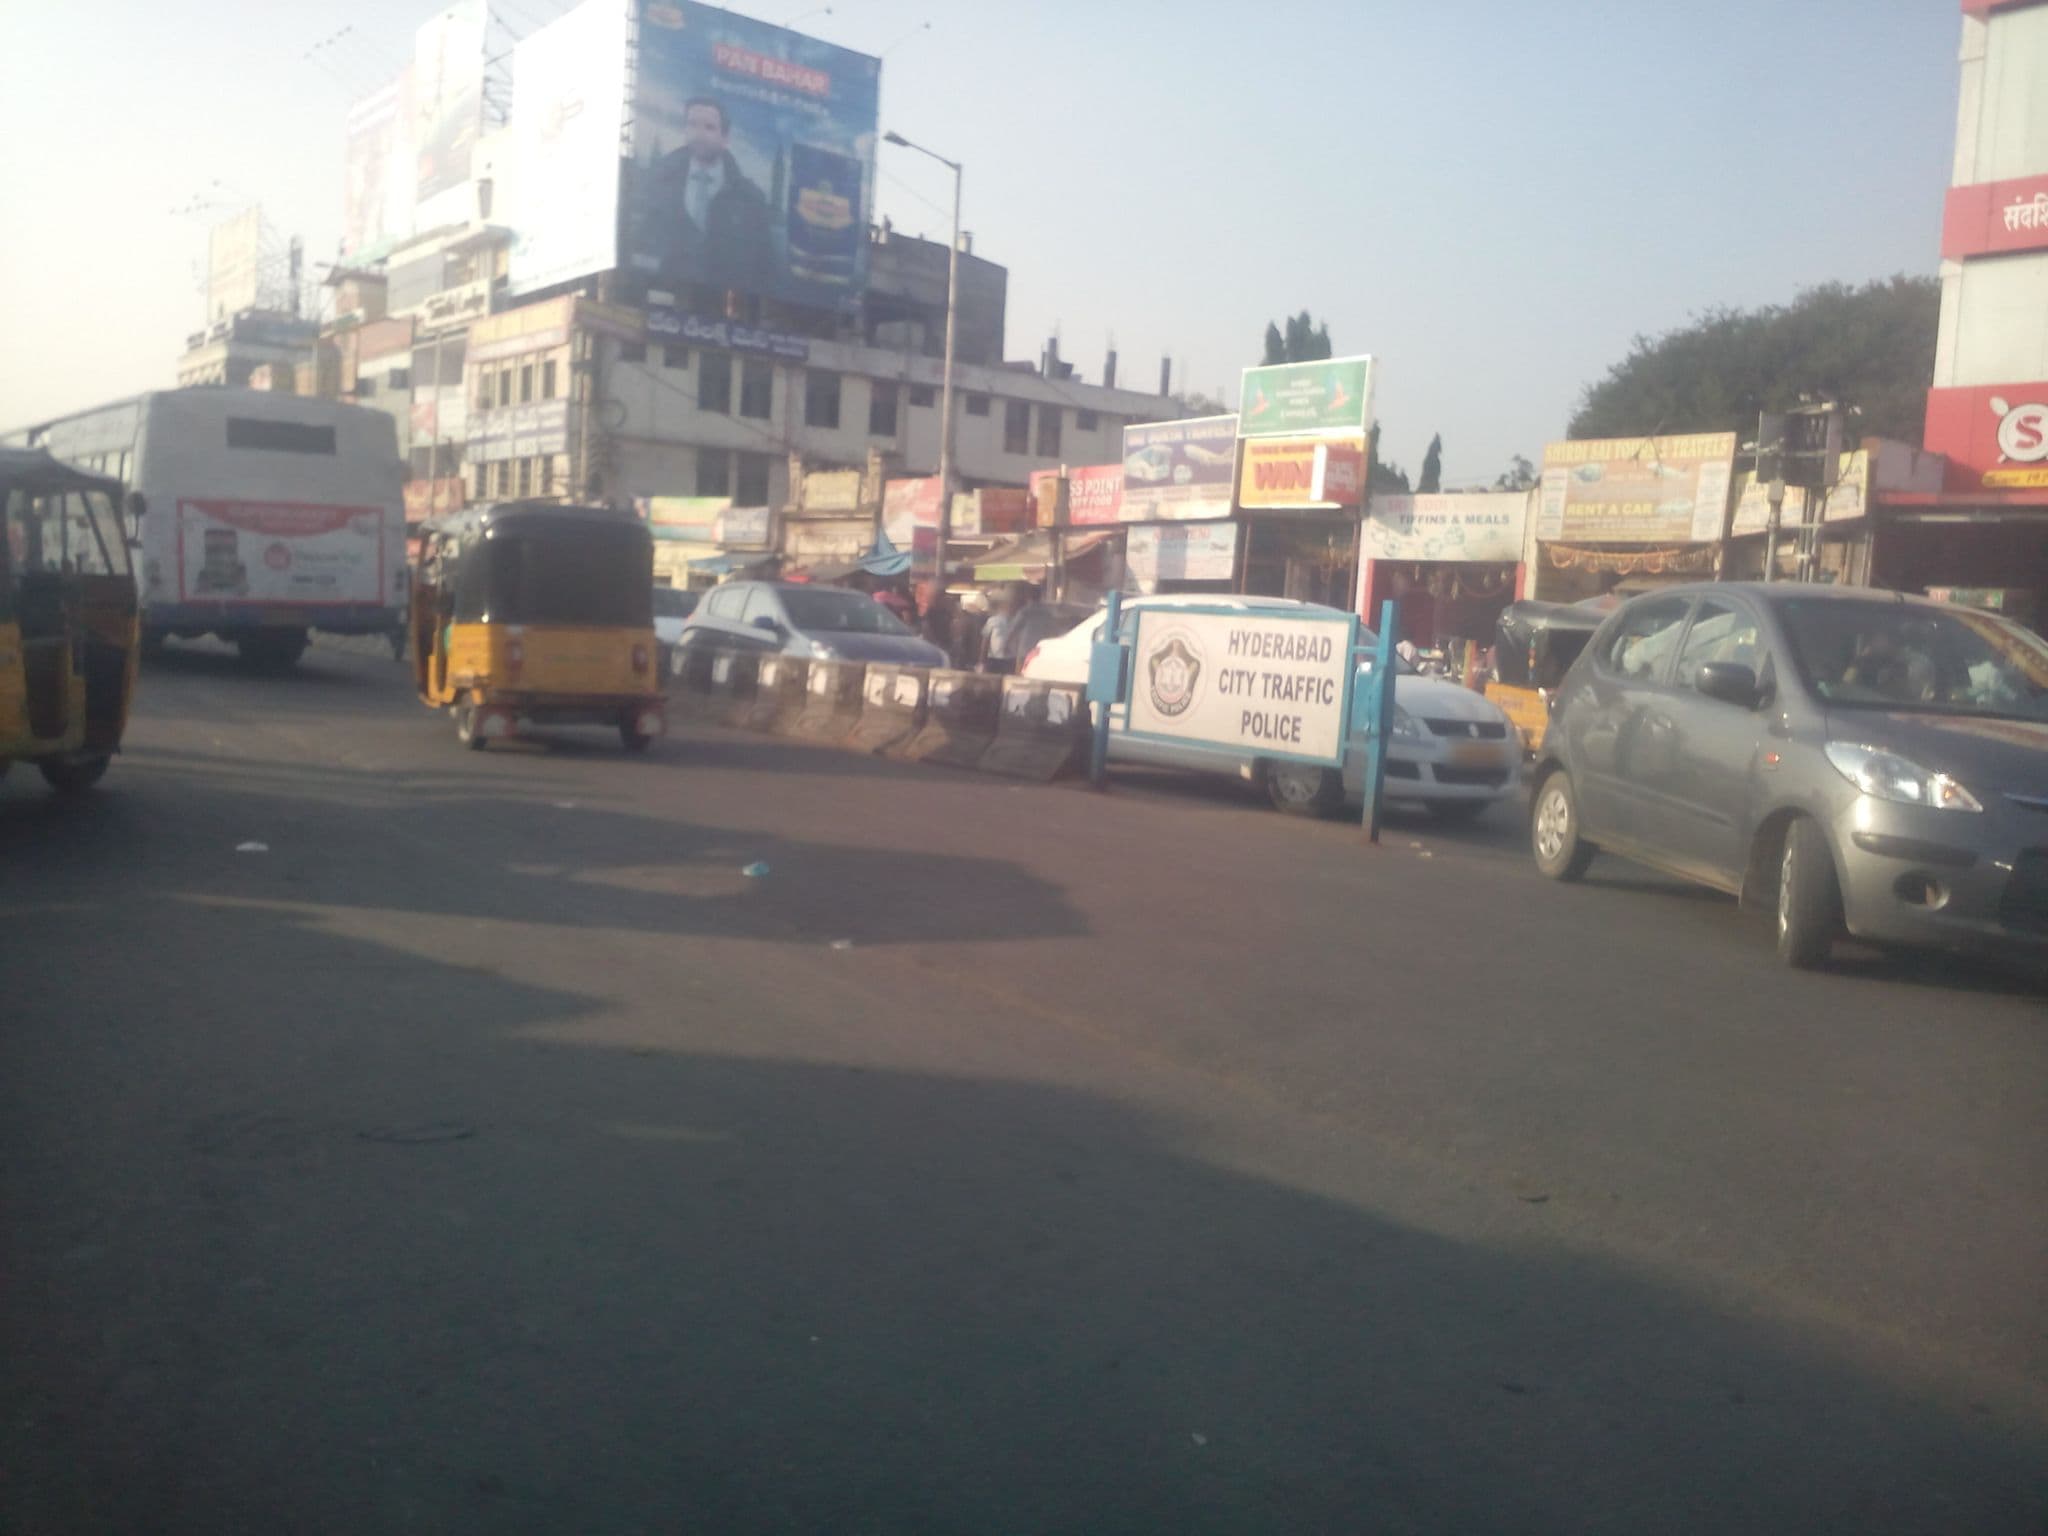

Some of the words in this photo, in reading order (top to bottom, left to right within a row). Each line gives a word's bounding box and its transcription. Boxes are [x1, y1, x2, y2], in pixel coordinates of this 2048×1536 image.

[716, 46, 757, 73] PAN
[762, 59, 826, 93] BAHAR
[1673, 434, 1730, 458] TRAVELS
[1085, 477, 1120, 497] POINT
[1399, 513, 1447, 525] TIFFINS
[1450, 514, 1461, 525] &
[1465, 513, 1510, 525] MEALS
[1566, 503, 1607, 517] RENT
[1608, 503, 1619, 516] A
[1622, 502, 1653, 516] CAR
[1227, 629, 1332, 664] HYDERABAD
[1218, 667, 1258, 698] CITY
[1261, 673, 1335, 706] TRAFFIC
[1241, 710, 1302, 743] POLICE
